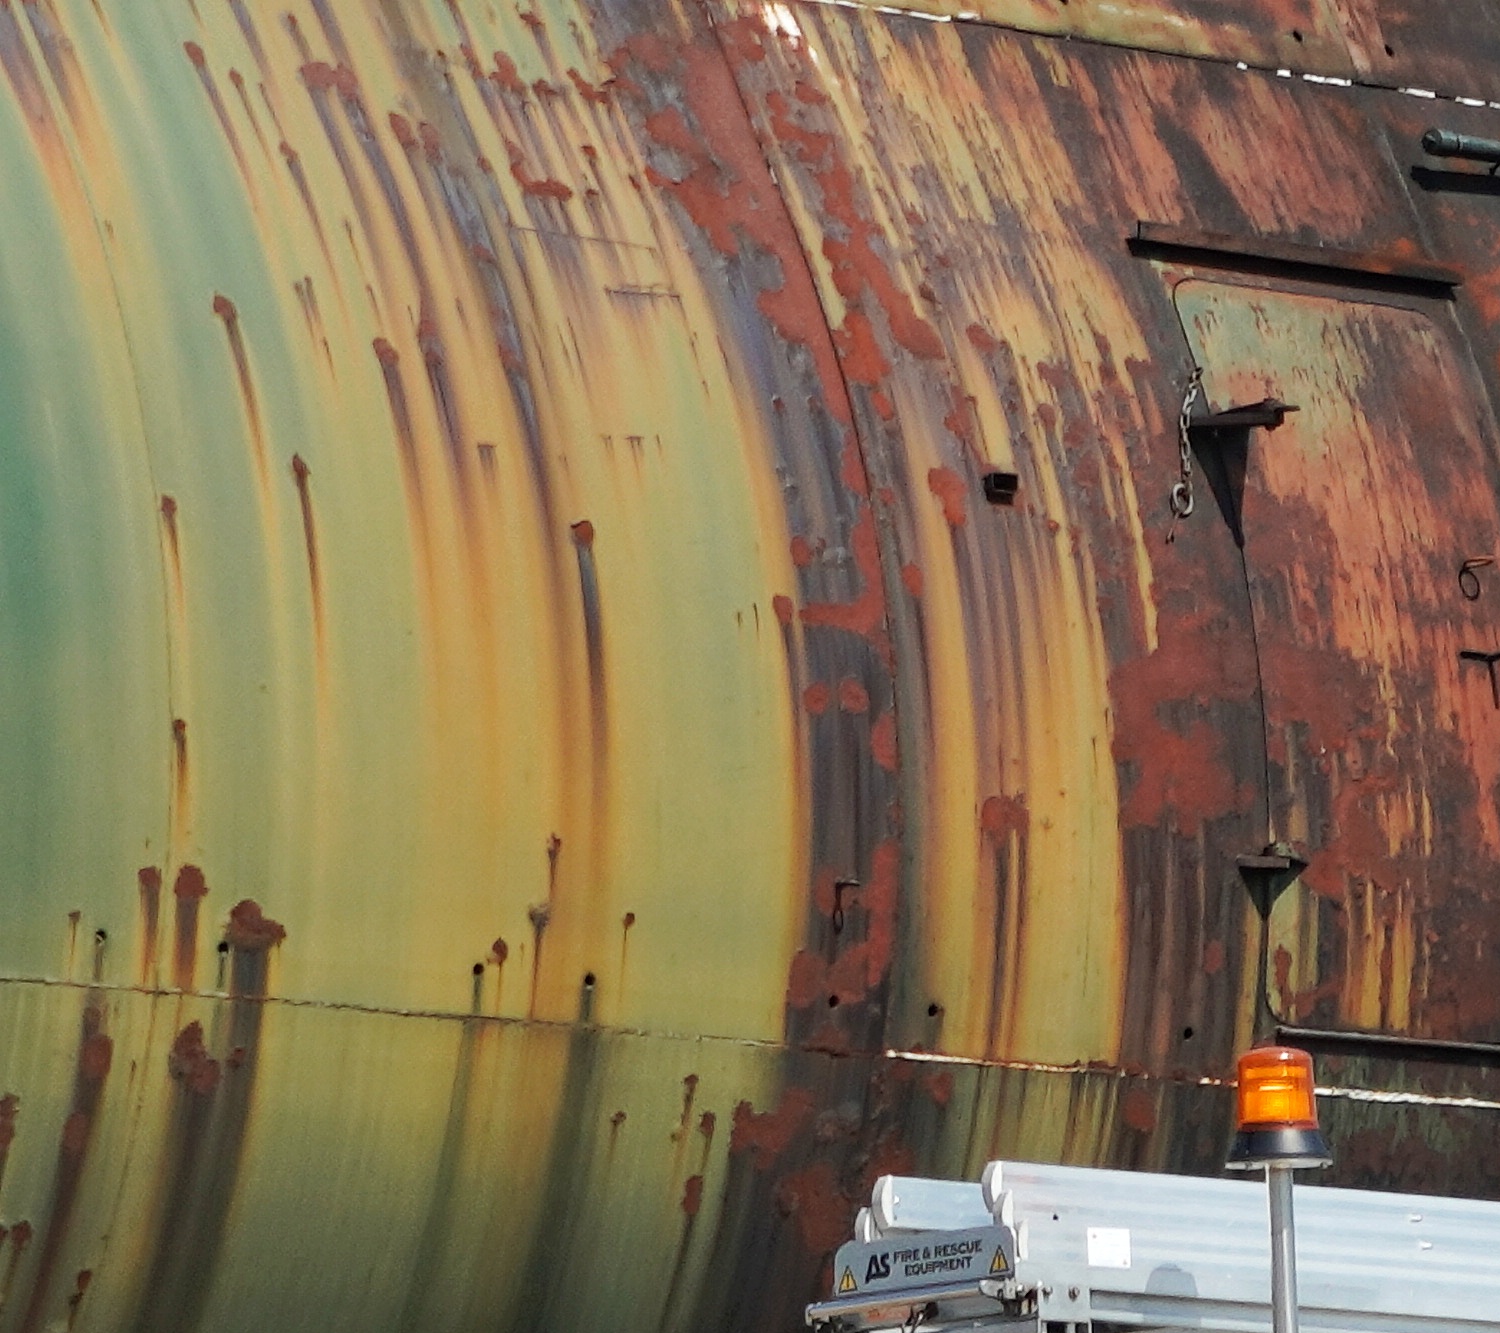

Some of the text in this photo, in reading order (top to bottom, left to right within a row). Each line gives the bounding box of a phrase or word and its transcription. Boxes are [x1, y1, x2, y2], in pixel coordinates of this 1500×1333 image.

[893, 1248, 922, 1264] FIRE
[934, 1239, 983, 1258] RESCUE
[904, 1256, 973, 1277] EQUIPMENT
